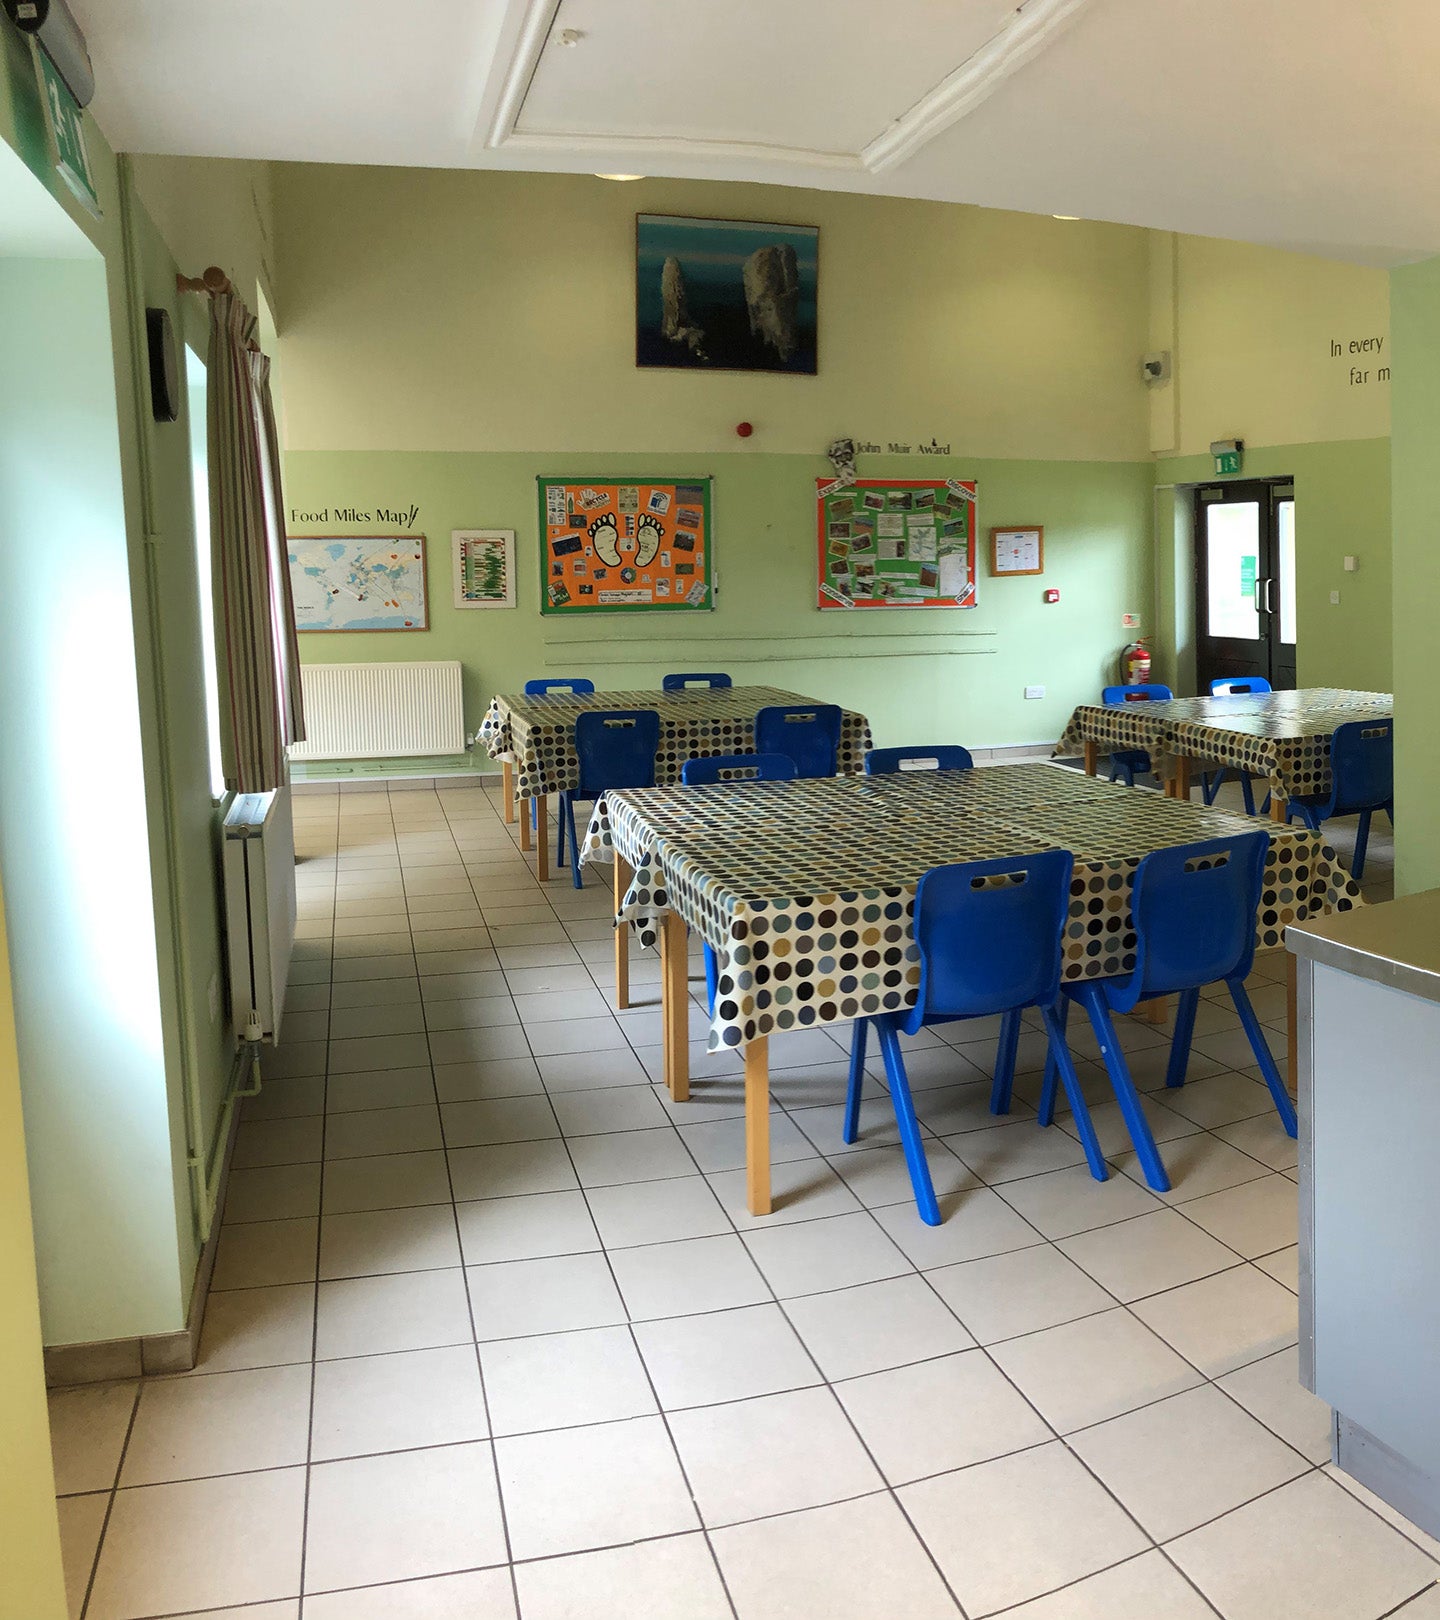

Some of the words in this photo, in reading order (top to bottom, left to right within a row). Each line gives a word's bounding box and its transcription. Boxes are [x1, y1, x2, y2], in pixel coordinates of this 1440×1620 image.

[1330, 339, 1342, 357] In
[1349, 336, 1384, 354] every
[1350, 366, 1370, 386] far
[855, 442, 881, 455] John
[888, 442, 912, 454] Muir
[918, 443, 951, 455] Award
[291, 508, 328, 522] Food
[334, 508, 371, 522] Miles
[376, 508, 408, 526] Map
